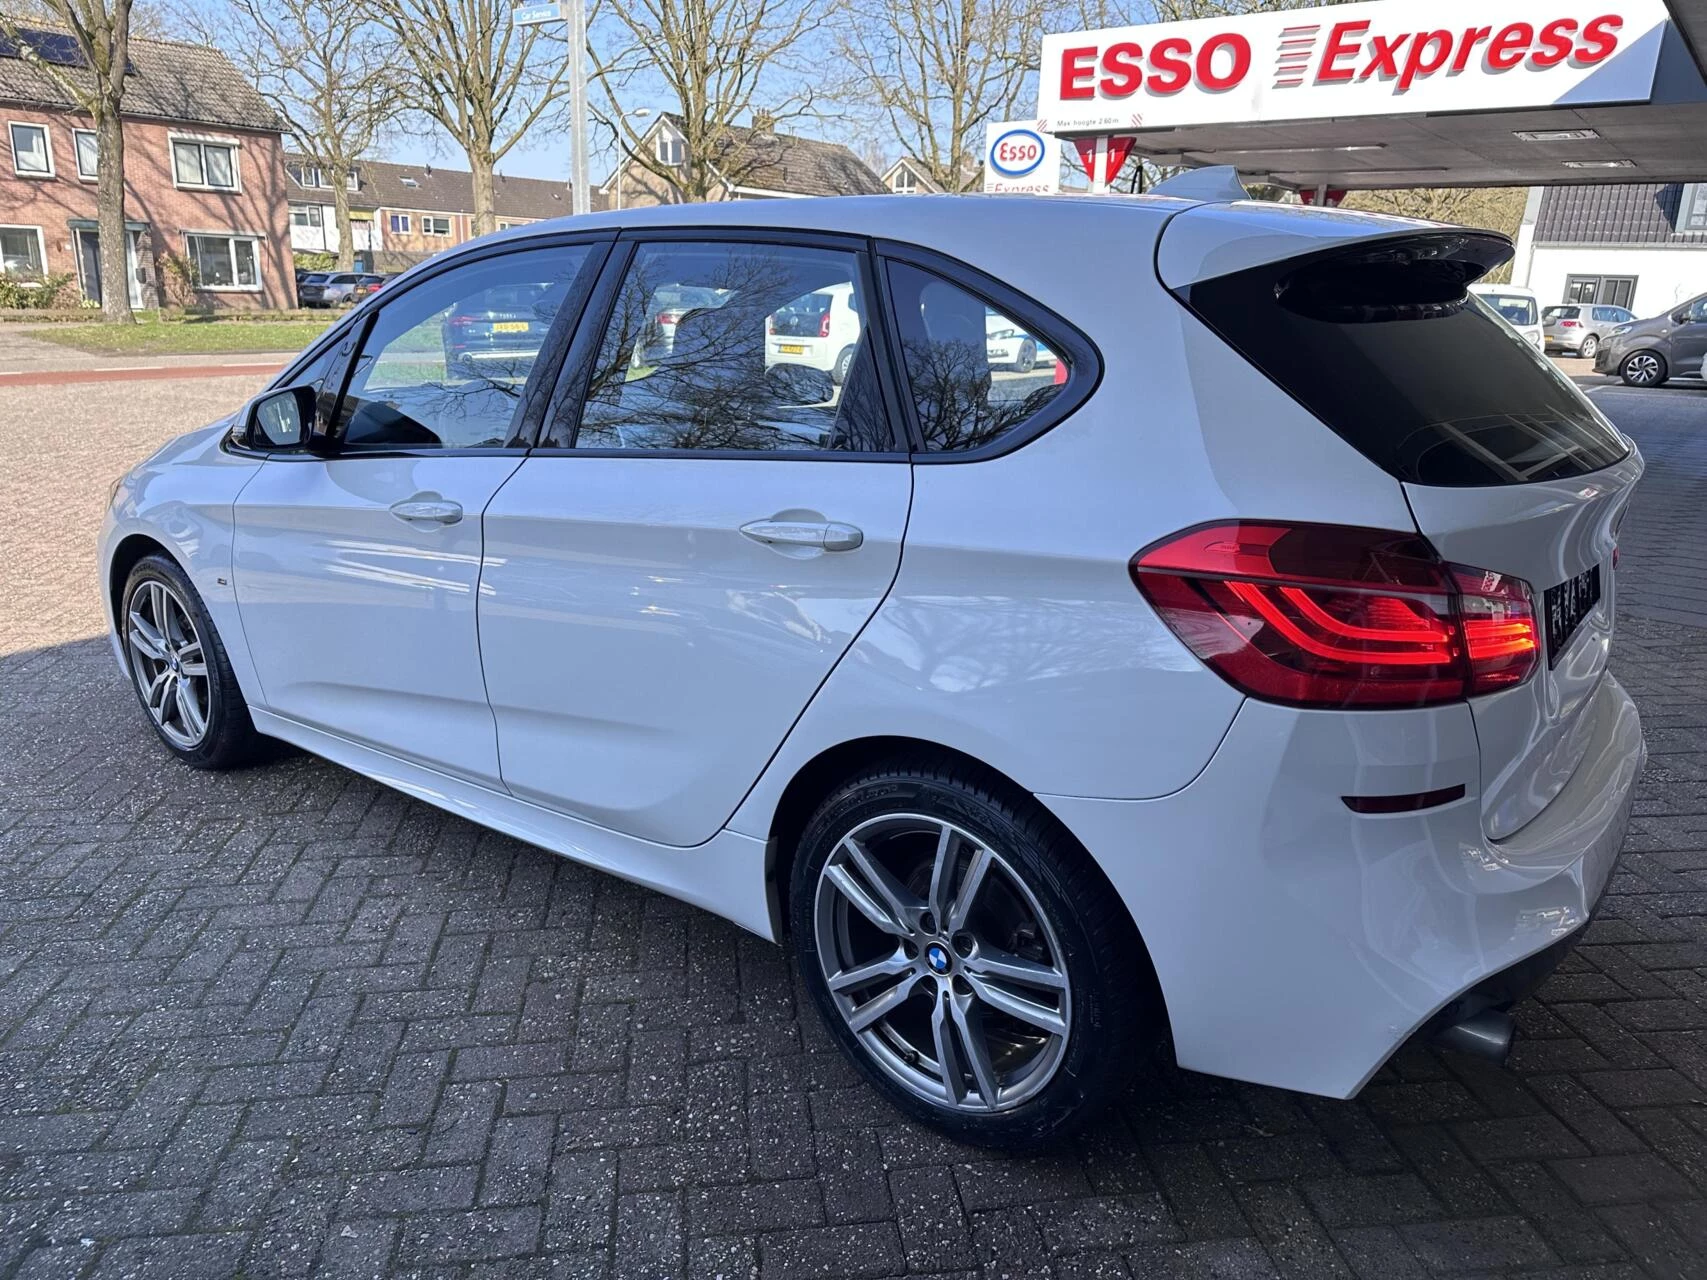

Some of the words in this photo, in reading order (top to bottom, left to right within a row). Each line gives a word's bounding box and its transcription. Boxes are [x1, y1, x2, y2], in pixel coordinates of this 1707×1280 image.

[1060, 33, 1252, 100] ESSO
[1316, 14, 1624, 91] Express
[1000, 142, 1037, 162] Esso
[1086, 148, 1093, 164] 1
[1109, 148, 1116, 163] 1
